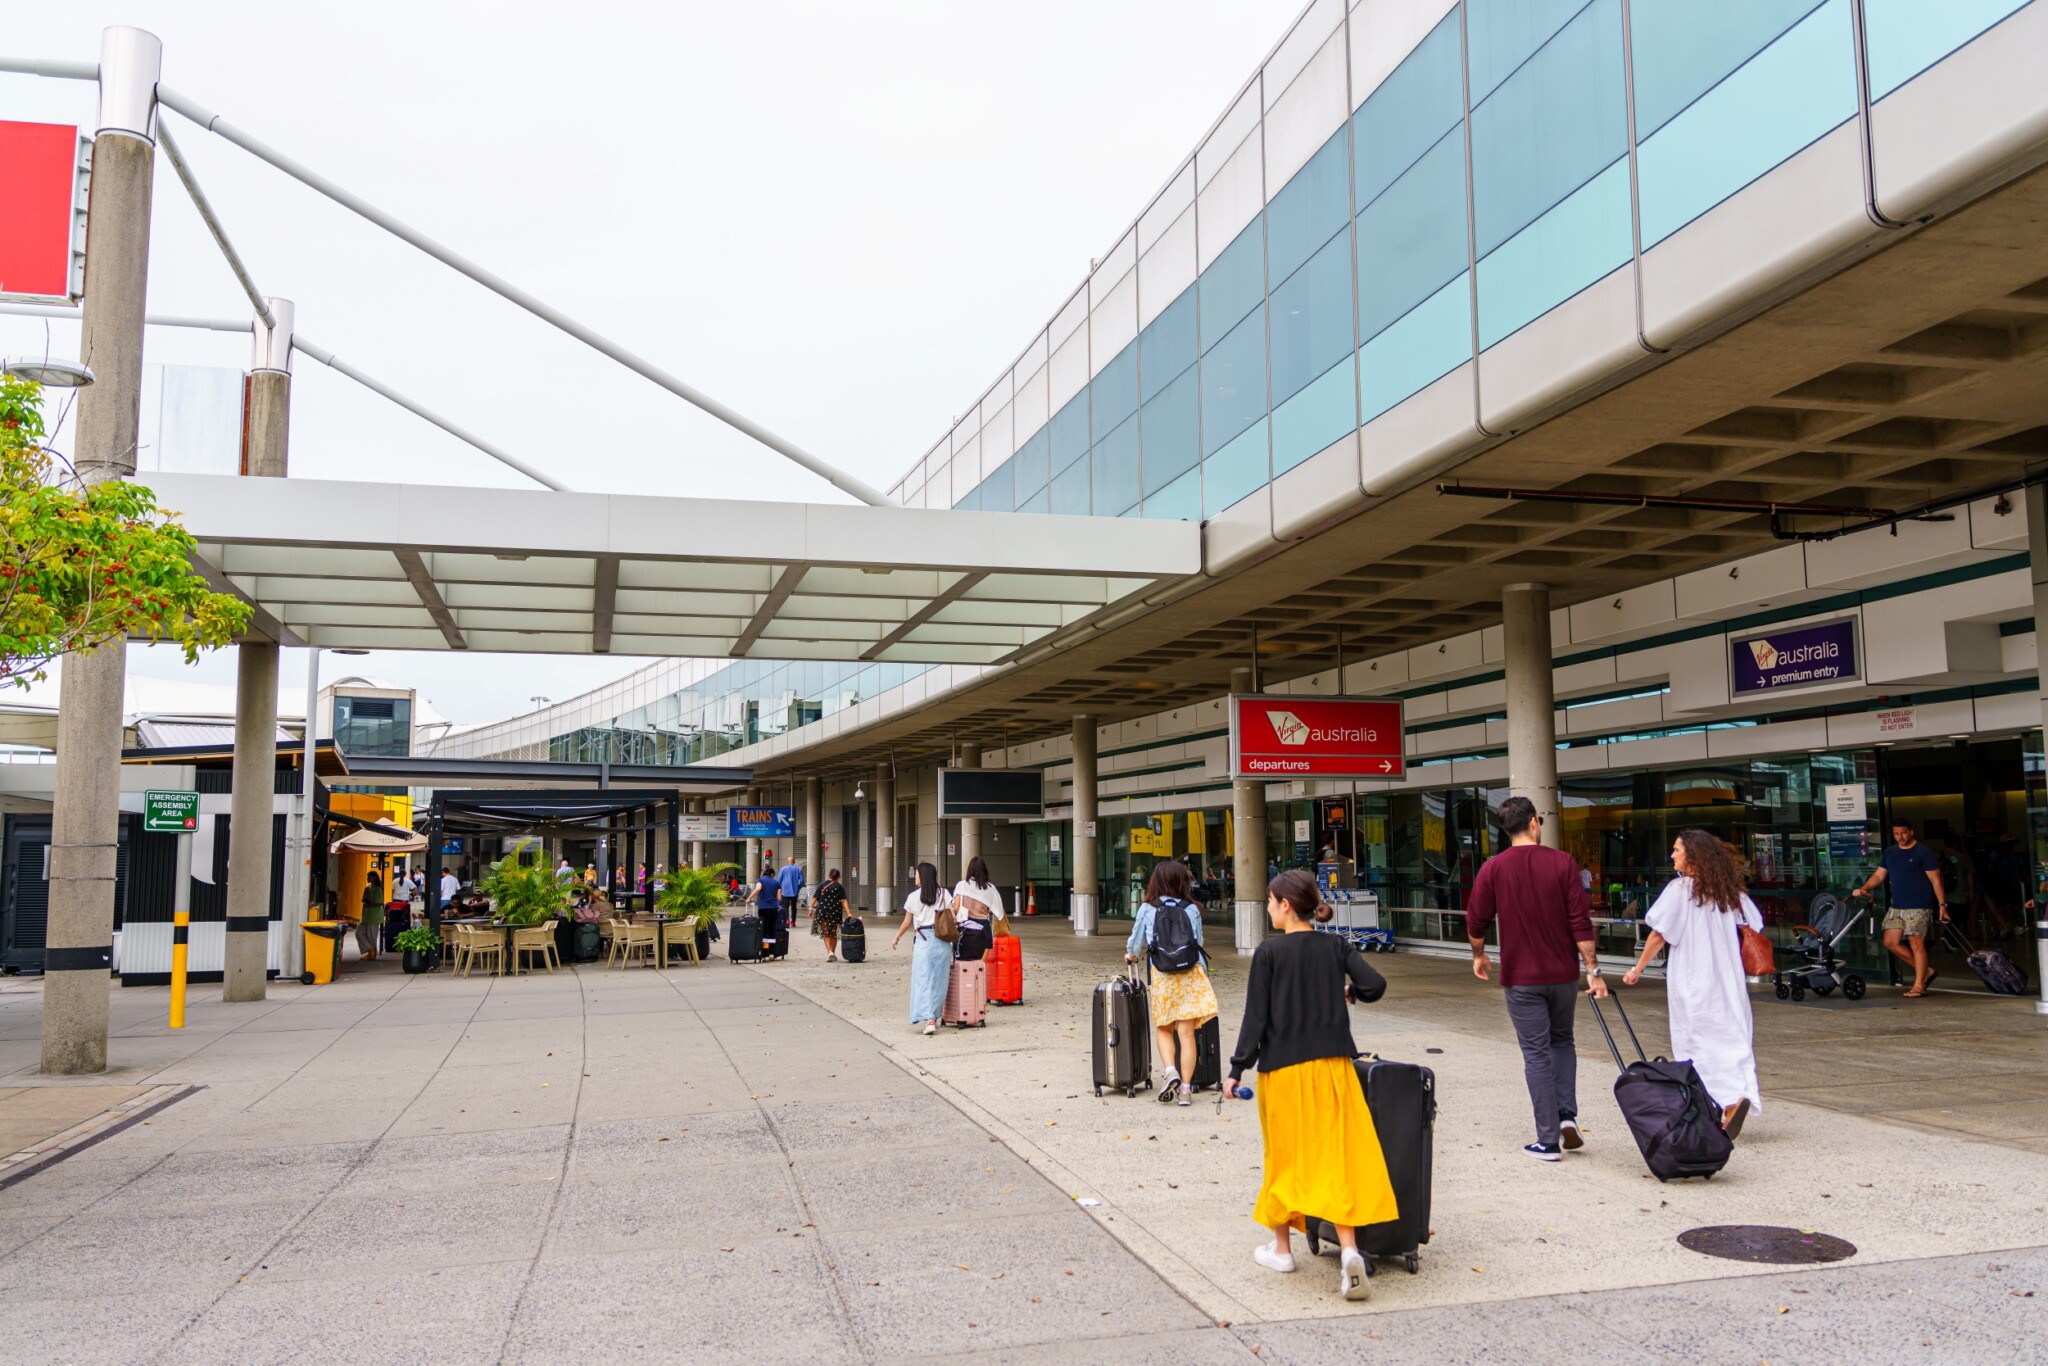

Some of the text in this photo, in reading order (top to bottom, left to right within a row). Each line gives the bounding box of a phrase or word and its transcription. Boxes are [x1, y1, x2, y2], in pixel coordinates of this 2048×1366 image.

[1756, 642, 1839, 667] Virgin australia
[1772, 666, 1839, 686] premium entry
[1888, 716, 1910, 724] FLASHING
[1898, 722, 1913, 730] ENTER
[1277, 716, 1377, 743] Virgin australia
[1249, 759, 1310, 771] departures
[736, 810, 773, 823] TRAINS
